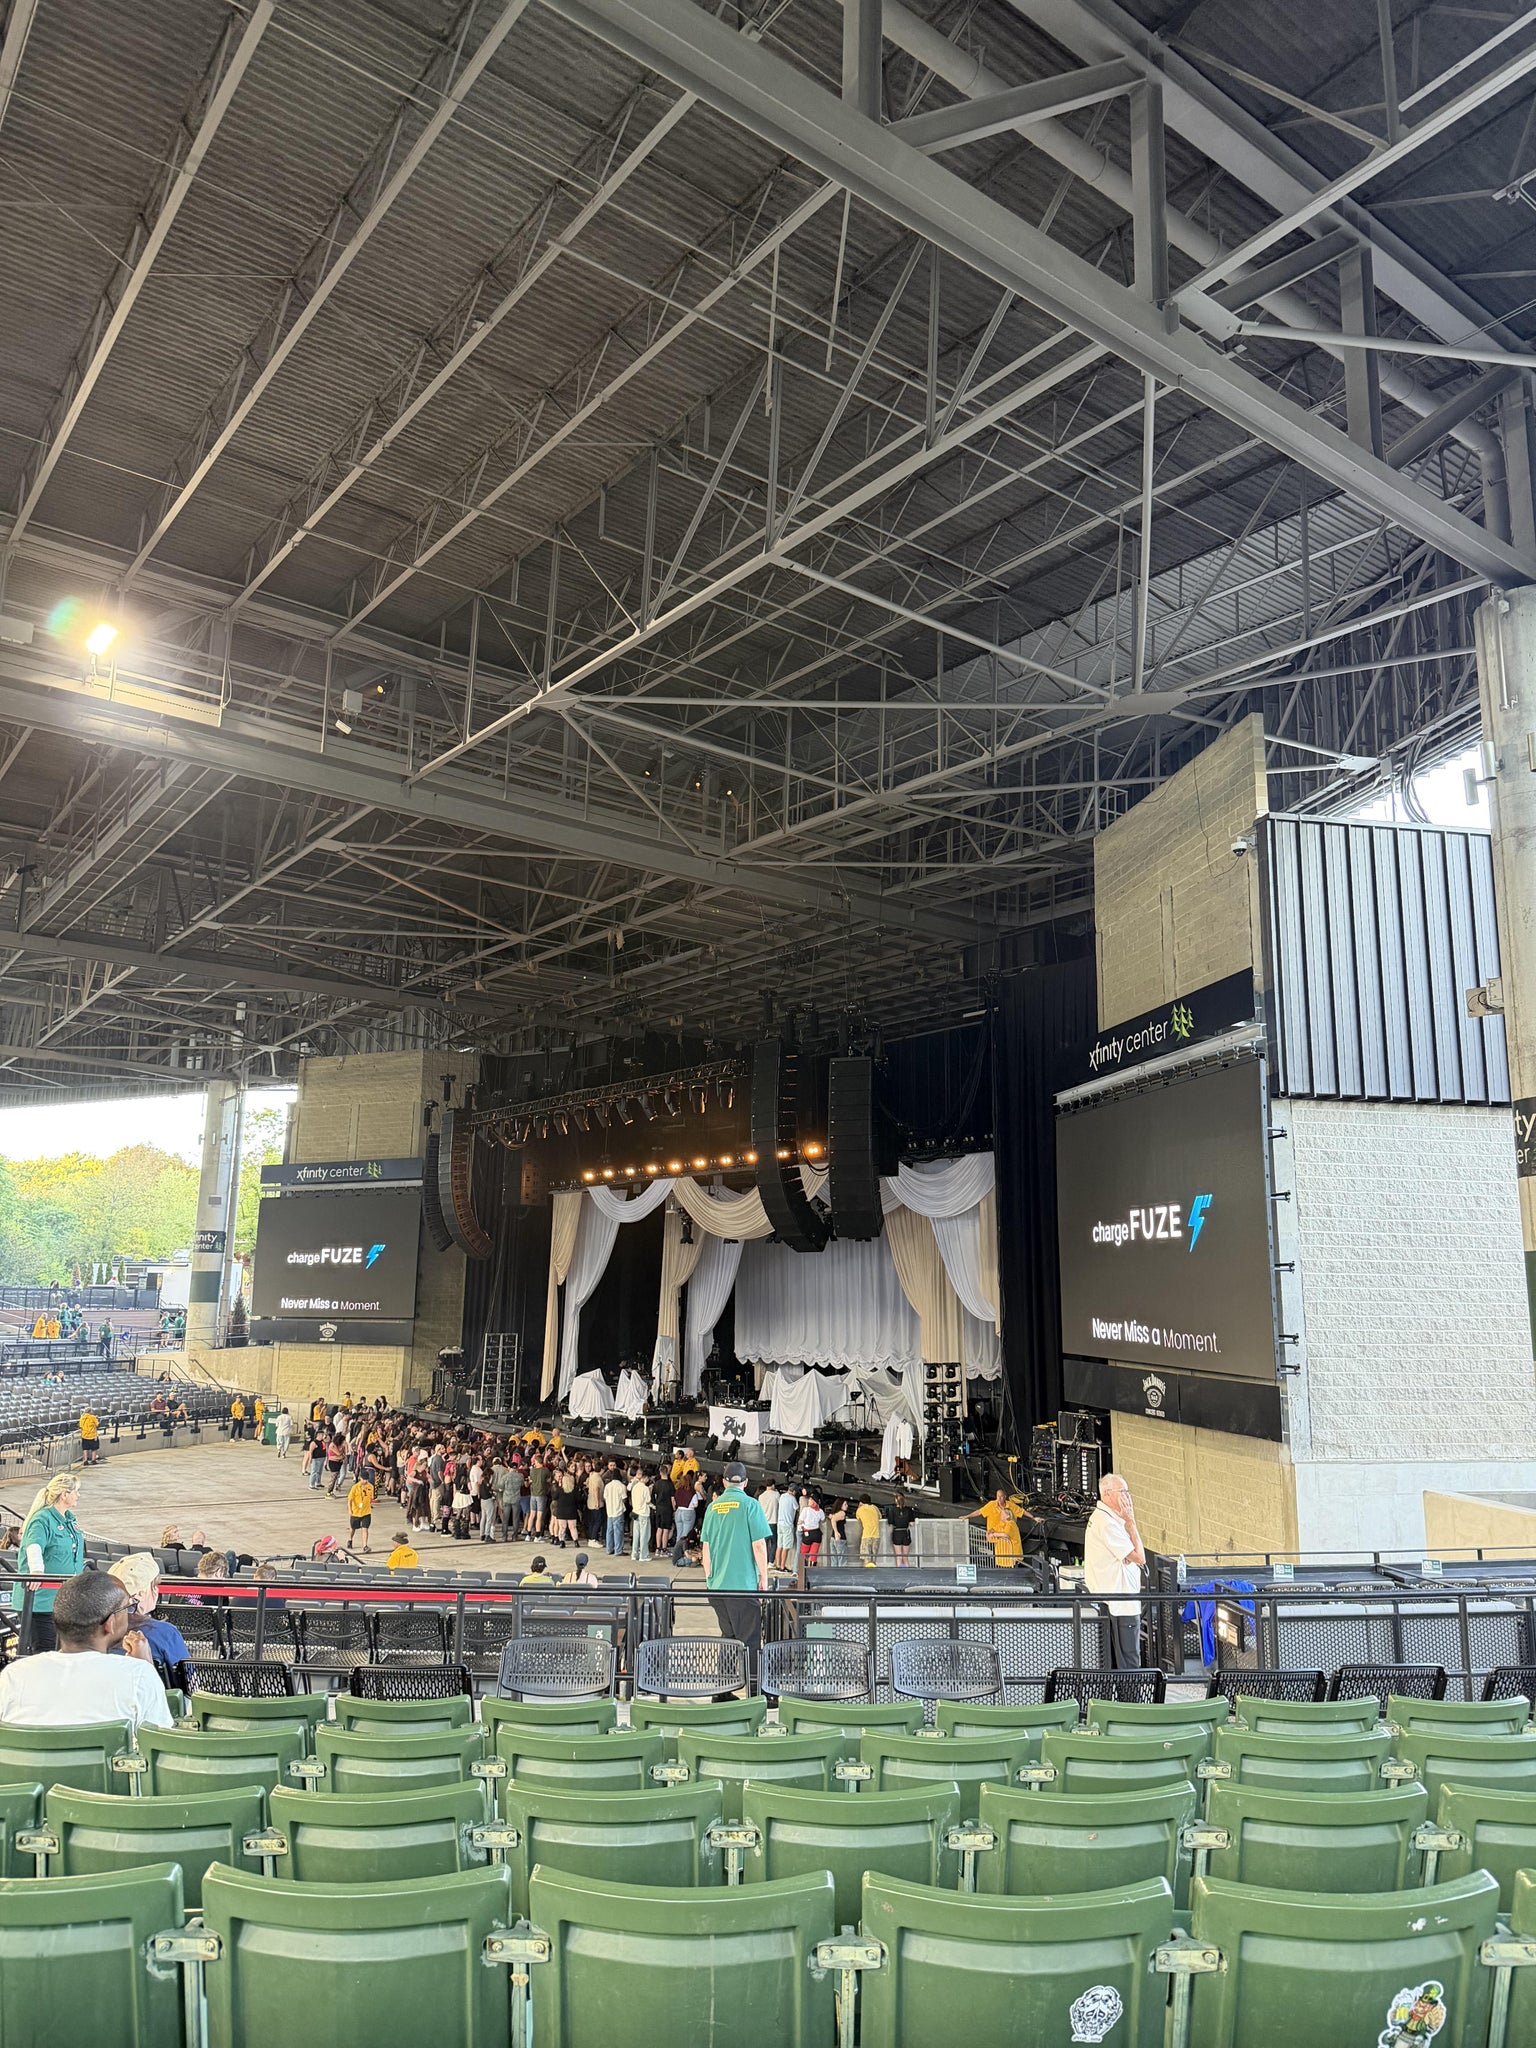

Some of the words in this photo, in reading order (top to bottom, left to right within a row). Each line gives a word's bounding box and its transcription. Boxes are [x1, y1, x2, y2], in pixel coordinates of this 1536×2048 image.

[1089, 1037, 1124, 1071] xfinity
[1126, 1021, 1168, 1053] center
[296, 1166, 328, 1181] xfinity
[330, 1166, 364, 1178] center
[1092, 1205, 1182, 1246] chargeFUZE
[287, 1247, 363, 1265] chargeFUZE
[281, 1297, 308, 1309] Never
[309, 1297, 330, 1309] Miss
[331, 1301, 339, 1310] a
[340, 1301, 381, 1311] Moment.
[1092, 1317, 1122, 1340] Never
[1124, 1320, 1149, 1343] Miss
[1151, 1328, 1161, 1345] a
[1163, 1328, 1221, 1353] Moment.
